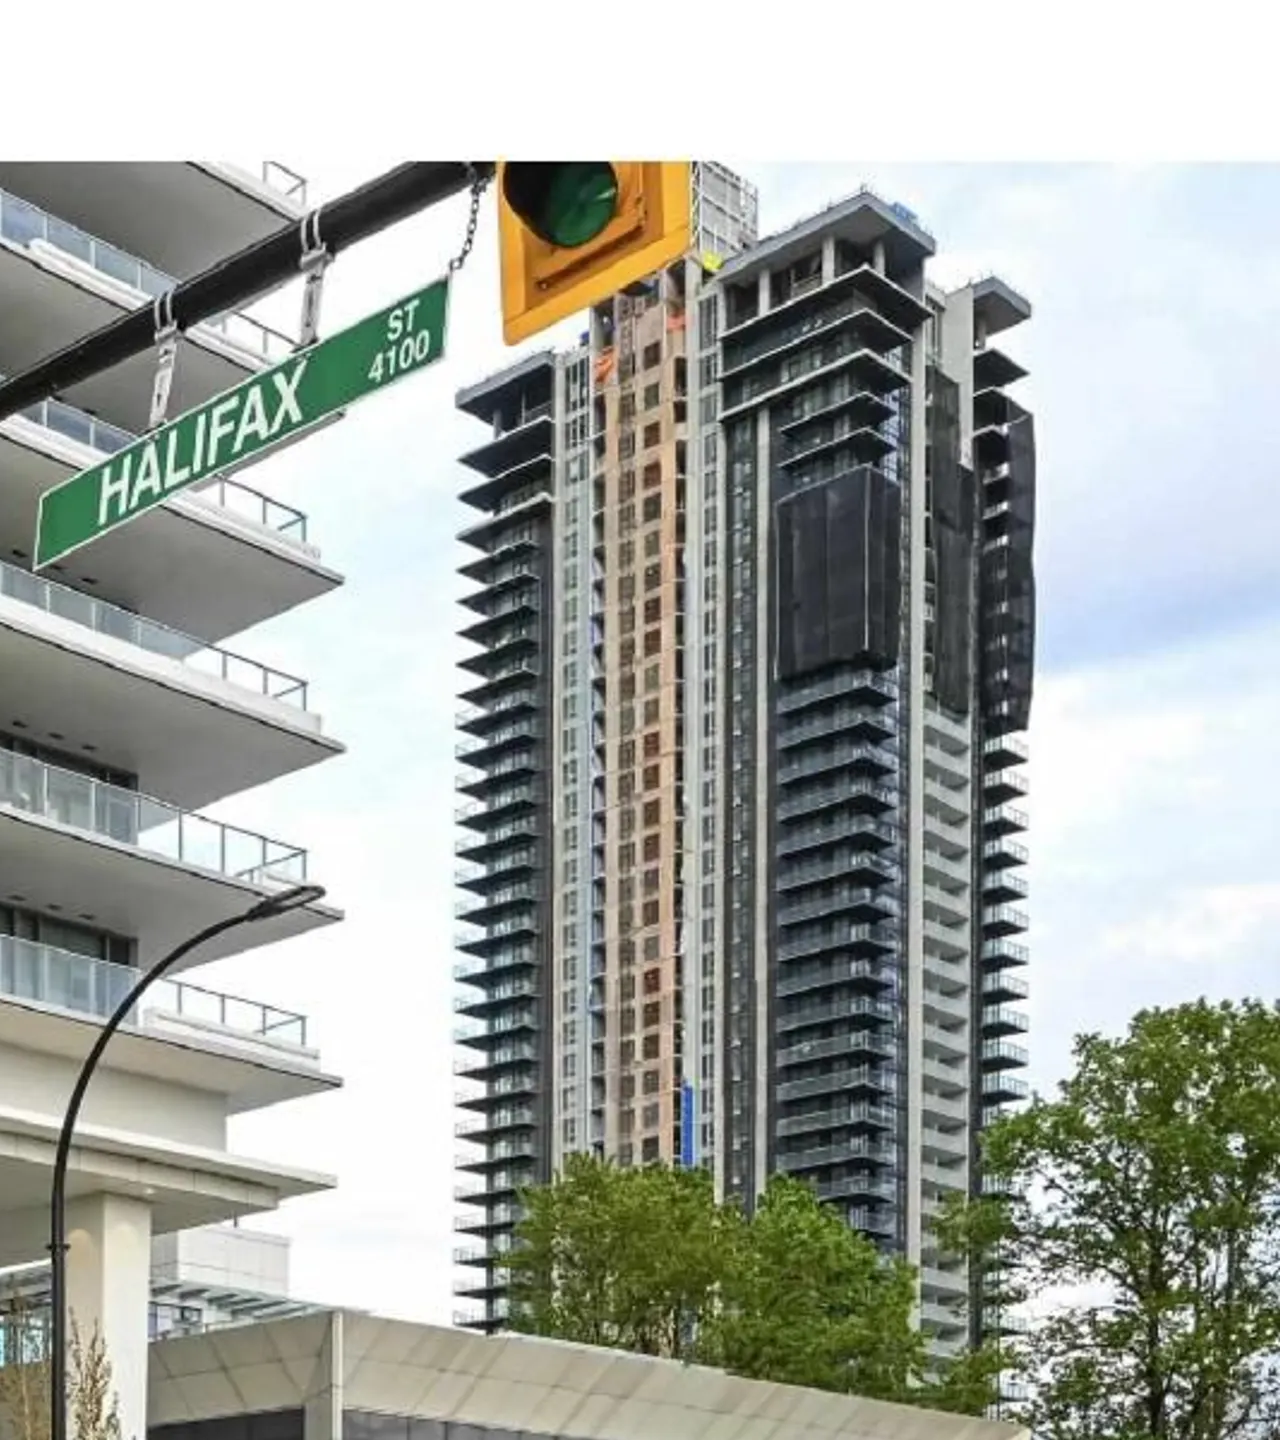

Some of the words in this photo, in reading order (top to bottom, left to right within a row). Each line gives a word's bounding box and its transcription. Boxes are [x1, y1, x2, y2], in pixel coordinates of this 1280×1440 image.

[97, 359, 306, 526] HALIFAX
[386, 299, 420, 341] ST
[368, 330, 430, 384] 4100
